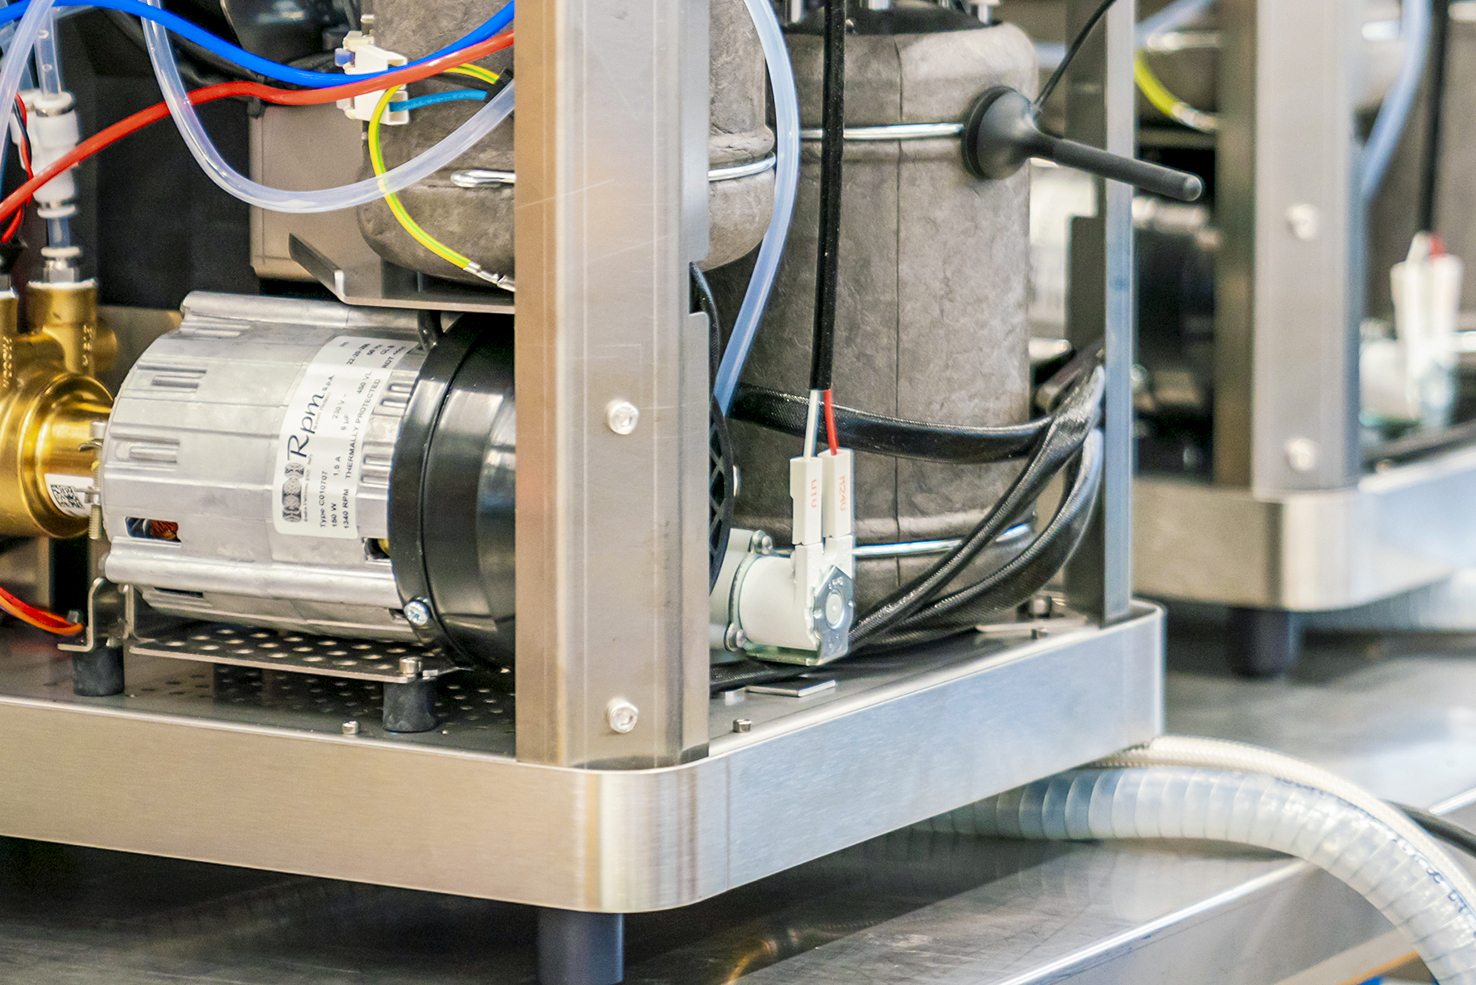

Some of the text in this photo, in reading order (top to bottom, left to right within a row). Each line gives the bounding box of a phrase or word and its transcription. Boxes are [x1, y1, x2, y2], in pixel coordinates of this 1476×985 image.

[287, 393, 326, 461] Rpm
[346, 426, 359, 479] THERMALLY
[355, 378, 381, 424] PROTECTED
